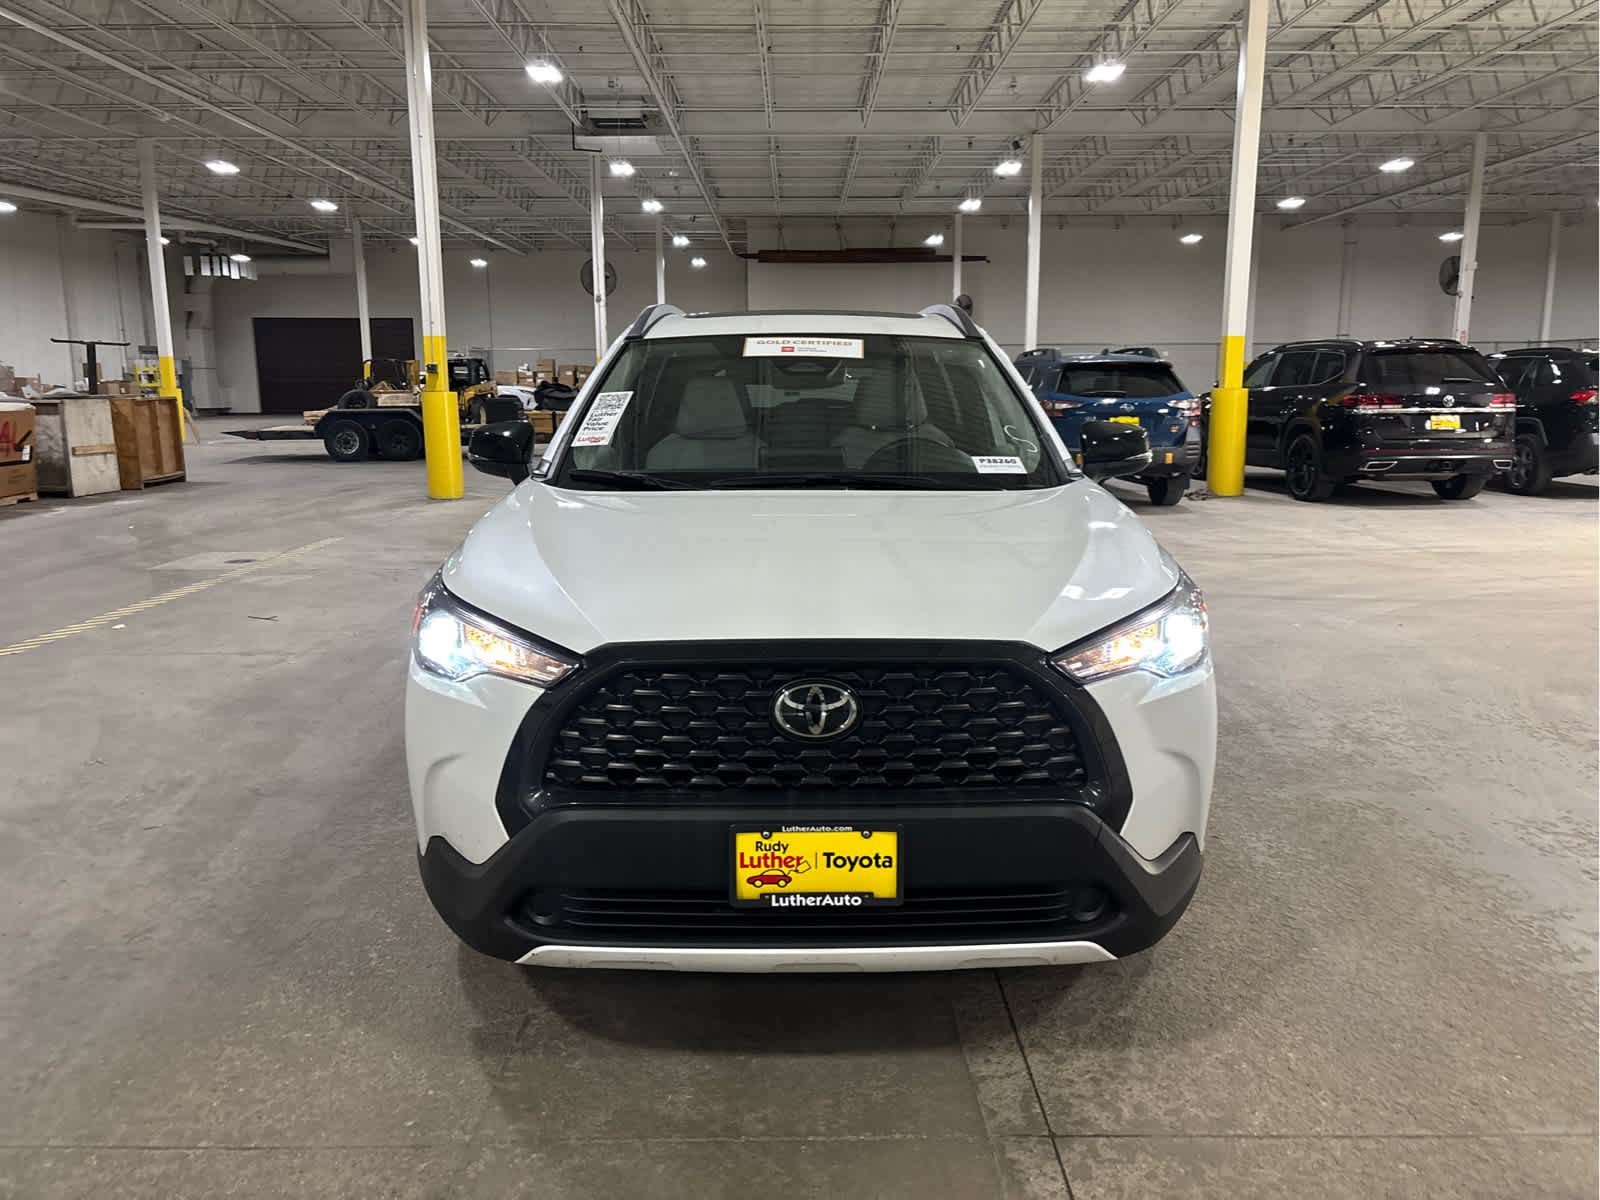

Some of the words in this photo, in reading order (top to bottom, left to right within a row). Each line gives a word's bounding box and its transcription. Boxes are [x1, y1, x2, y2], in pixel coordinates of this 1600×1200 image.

[755, 841, 789, 853] Rudy
[739, 852, 803, 868] Luther
[823, 852, 893, 872] Toyota
[771, 894, 862, 907] LutherAuto
